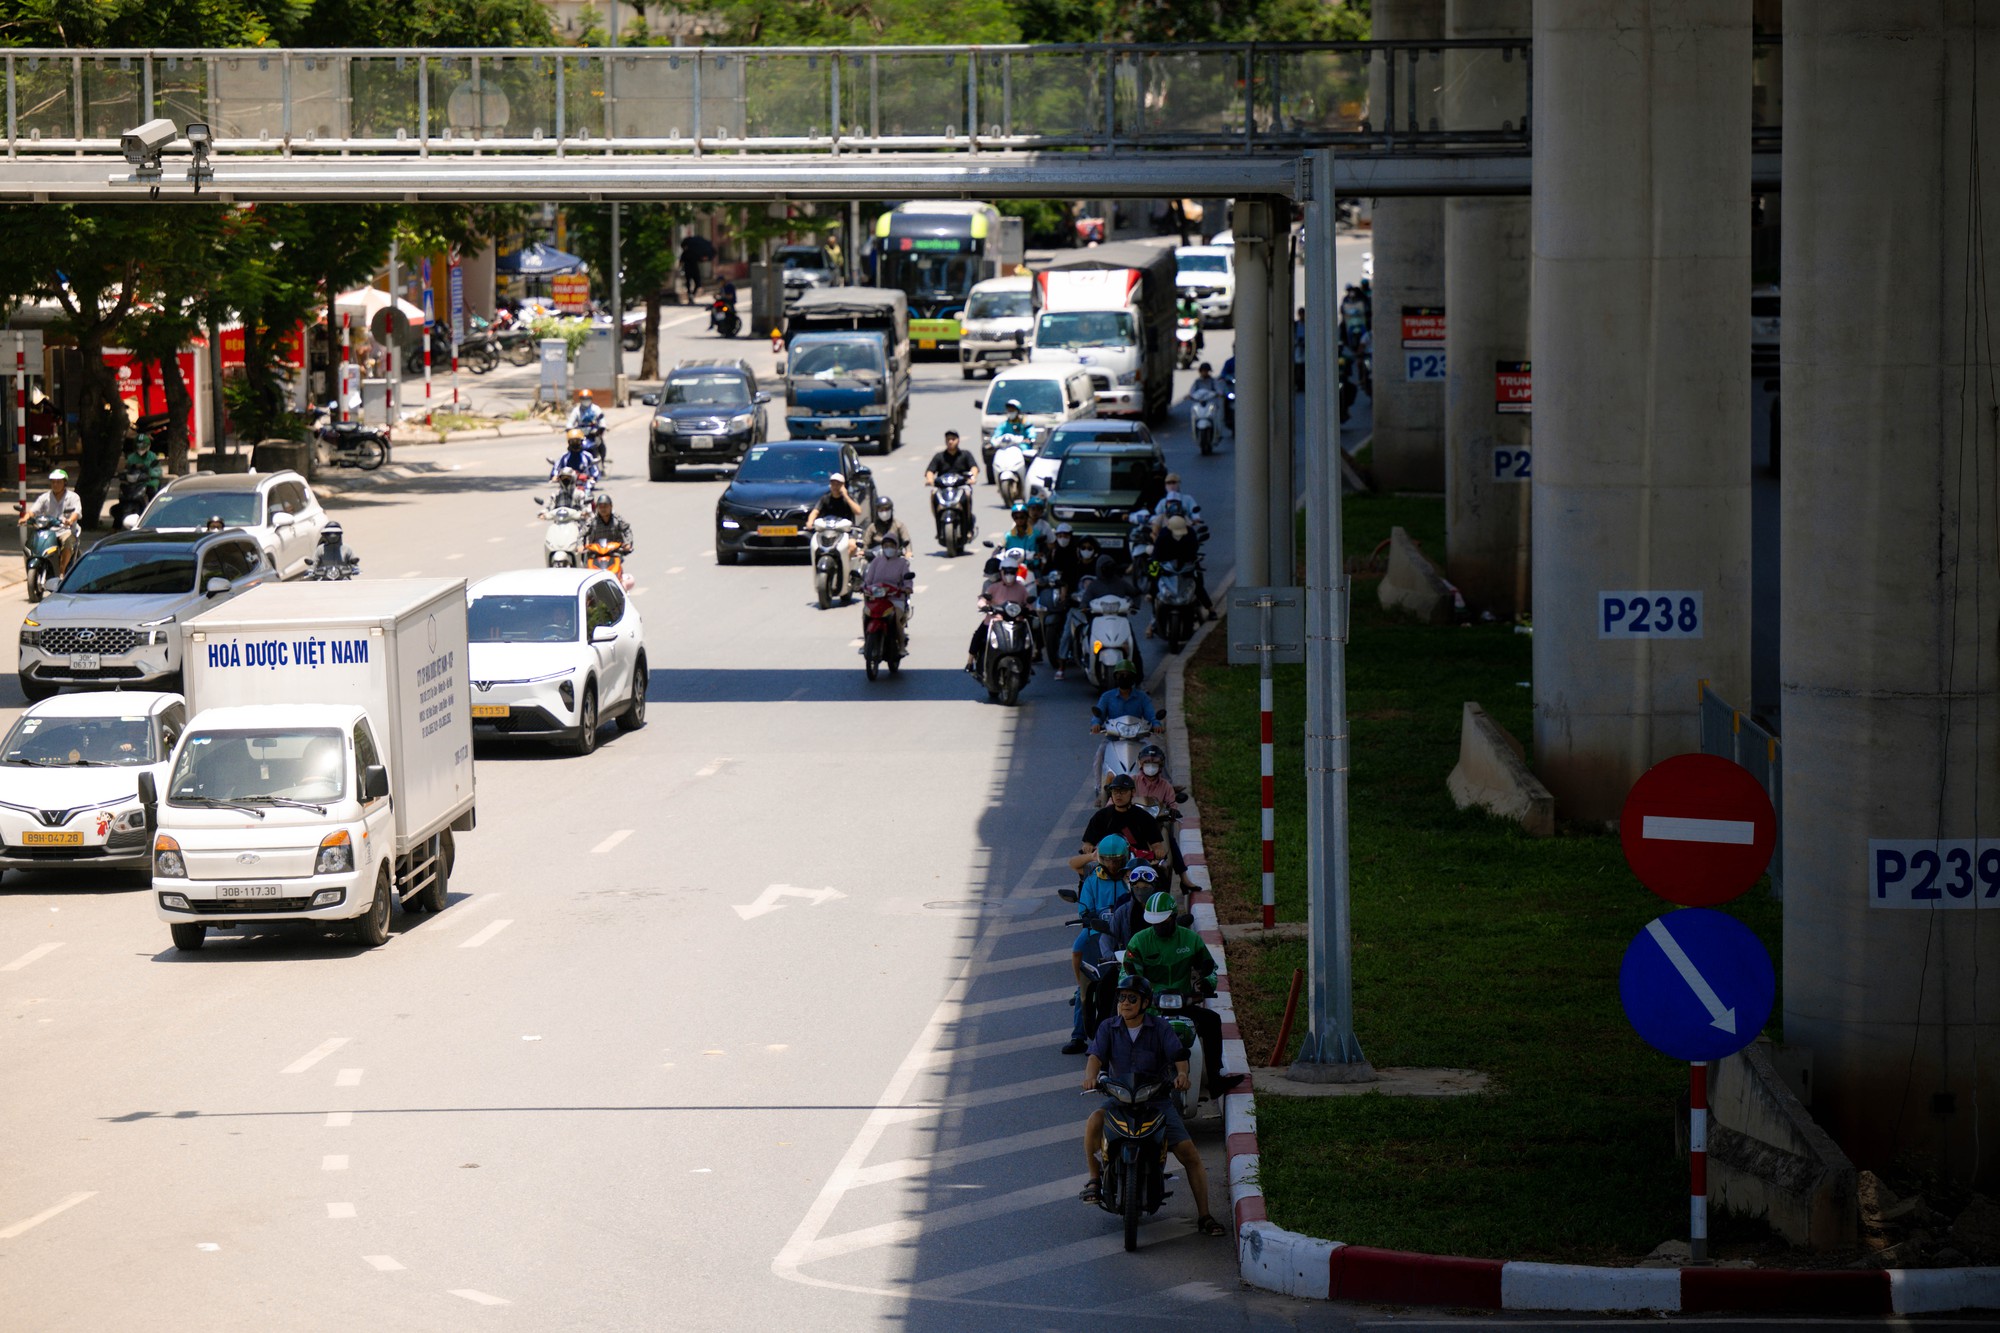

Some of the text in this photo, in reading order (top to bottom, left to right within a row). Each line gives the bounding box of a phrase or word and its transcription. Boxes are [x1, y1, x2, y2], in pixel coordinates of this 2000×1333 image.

[1413, 328, 1446, 338] LAPTO
[1498, 376, 1532, 387] TRUN
[1508, 388, 1532, 399] LAP
[1495, 450, 1532, 477] P2
[1604, 597, 1697, 632] P238
[208, 636, 369, 670] HOÁ DƯỢC VIỆT NAM
[27, 833, 79, 843] 89H-047.28
[1877, 848, 2000, 899] P239
[222, 886, 277, 897] 30B-117.30
[1176, 945, 1191, 954] Grab
